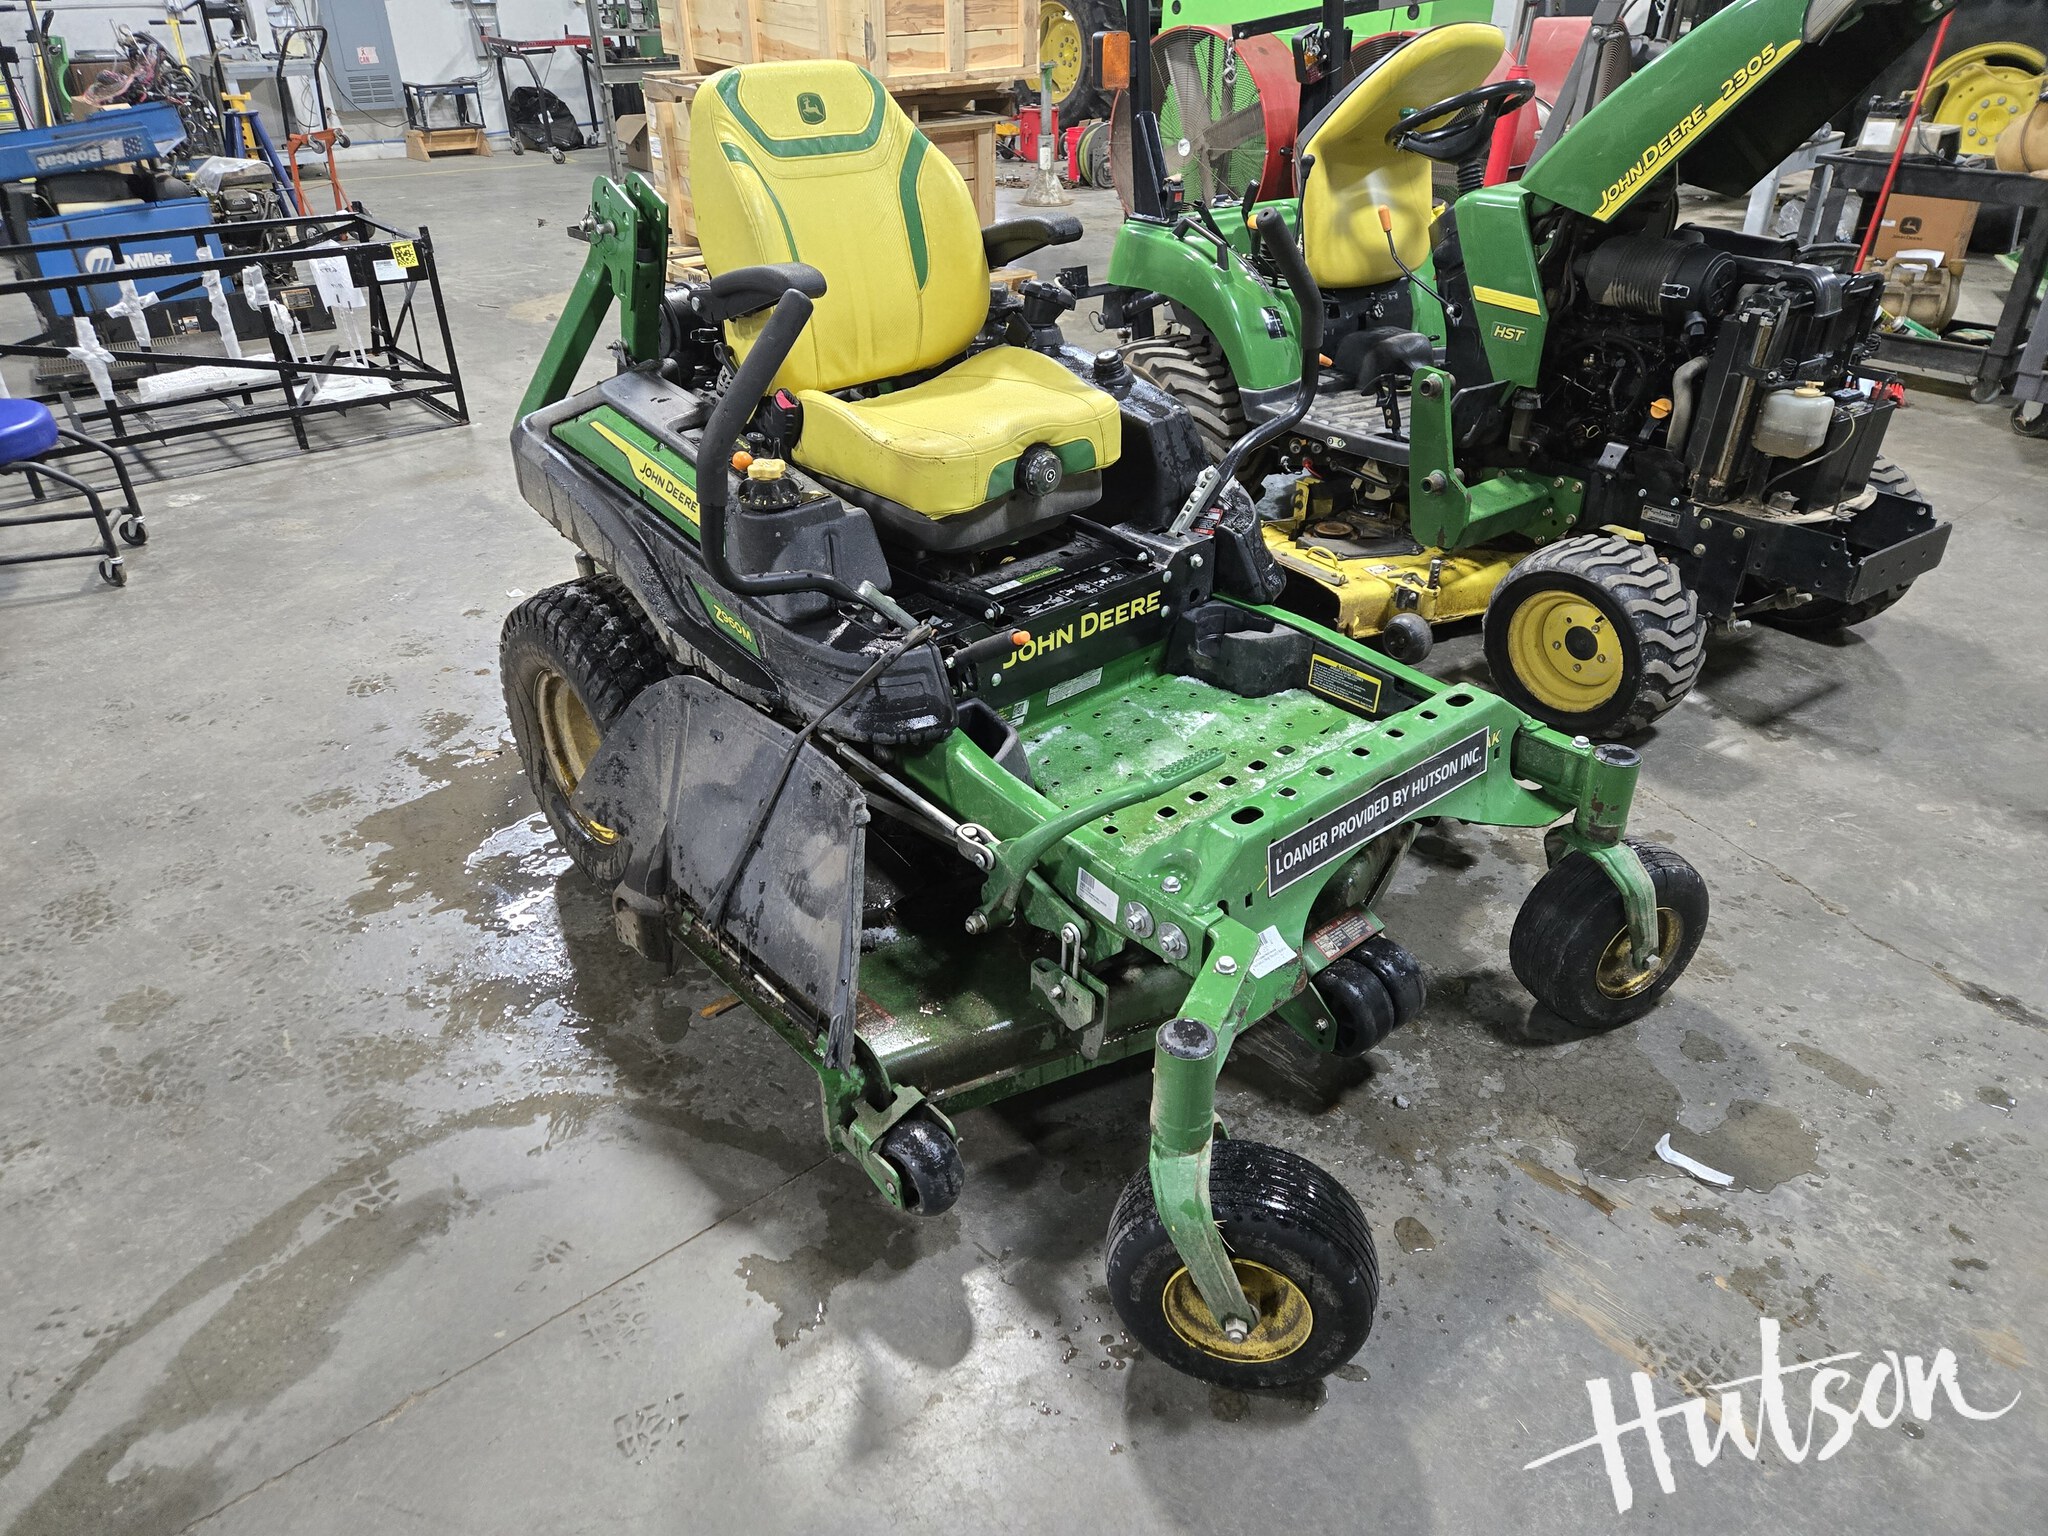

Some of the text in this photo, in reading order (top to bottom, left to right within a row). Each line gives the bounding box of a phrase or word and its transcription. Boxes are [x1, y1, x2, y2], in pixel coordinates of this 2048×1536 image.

[1599, 42, 1776, 212] JOHN DEERE 2305
[37, 147, 101, 170] Bobcat
[122, 252, 172, 269] Miller
[1493, 325, 1526, 342] HST
[640, 462, 698, 513] JOHN DEERE
[713, 604, 752, 643] Z960M
[1003, 590, 1161, 669] JOHN DEERE
[1275, 746, 1482, 875] LOANER PROVIDED BY HUTSON INC.
